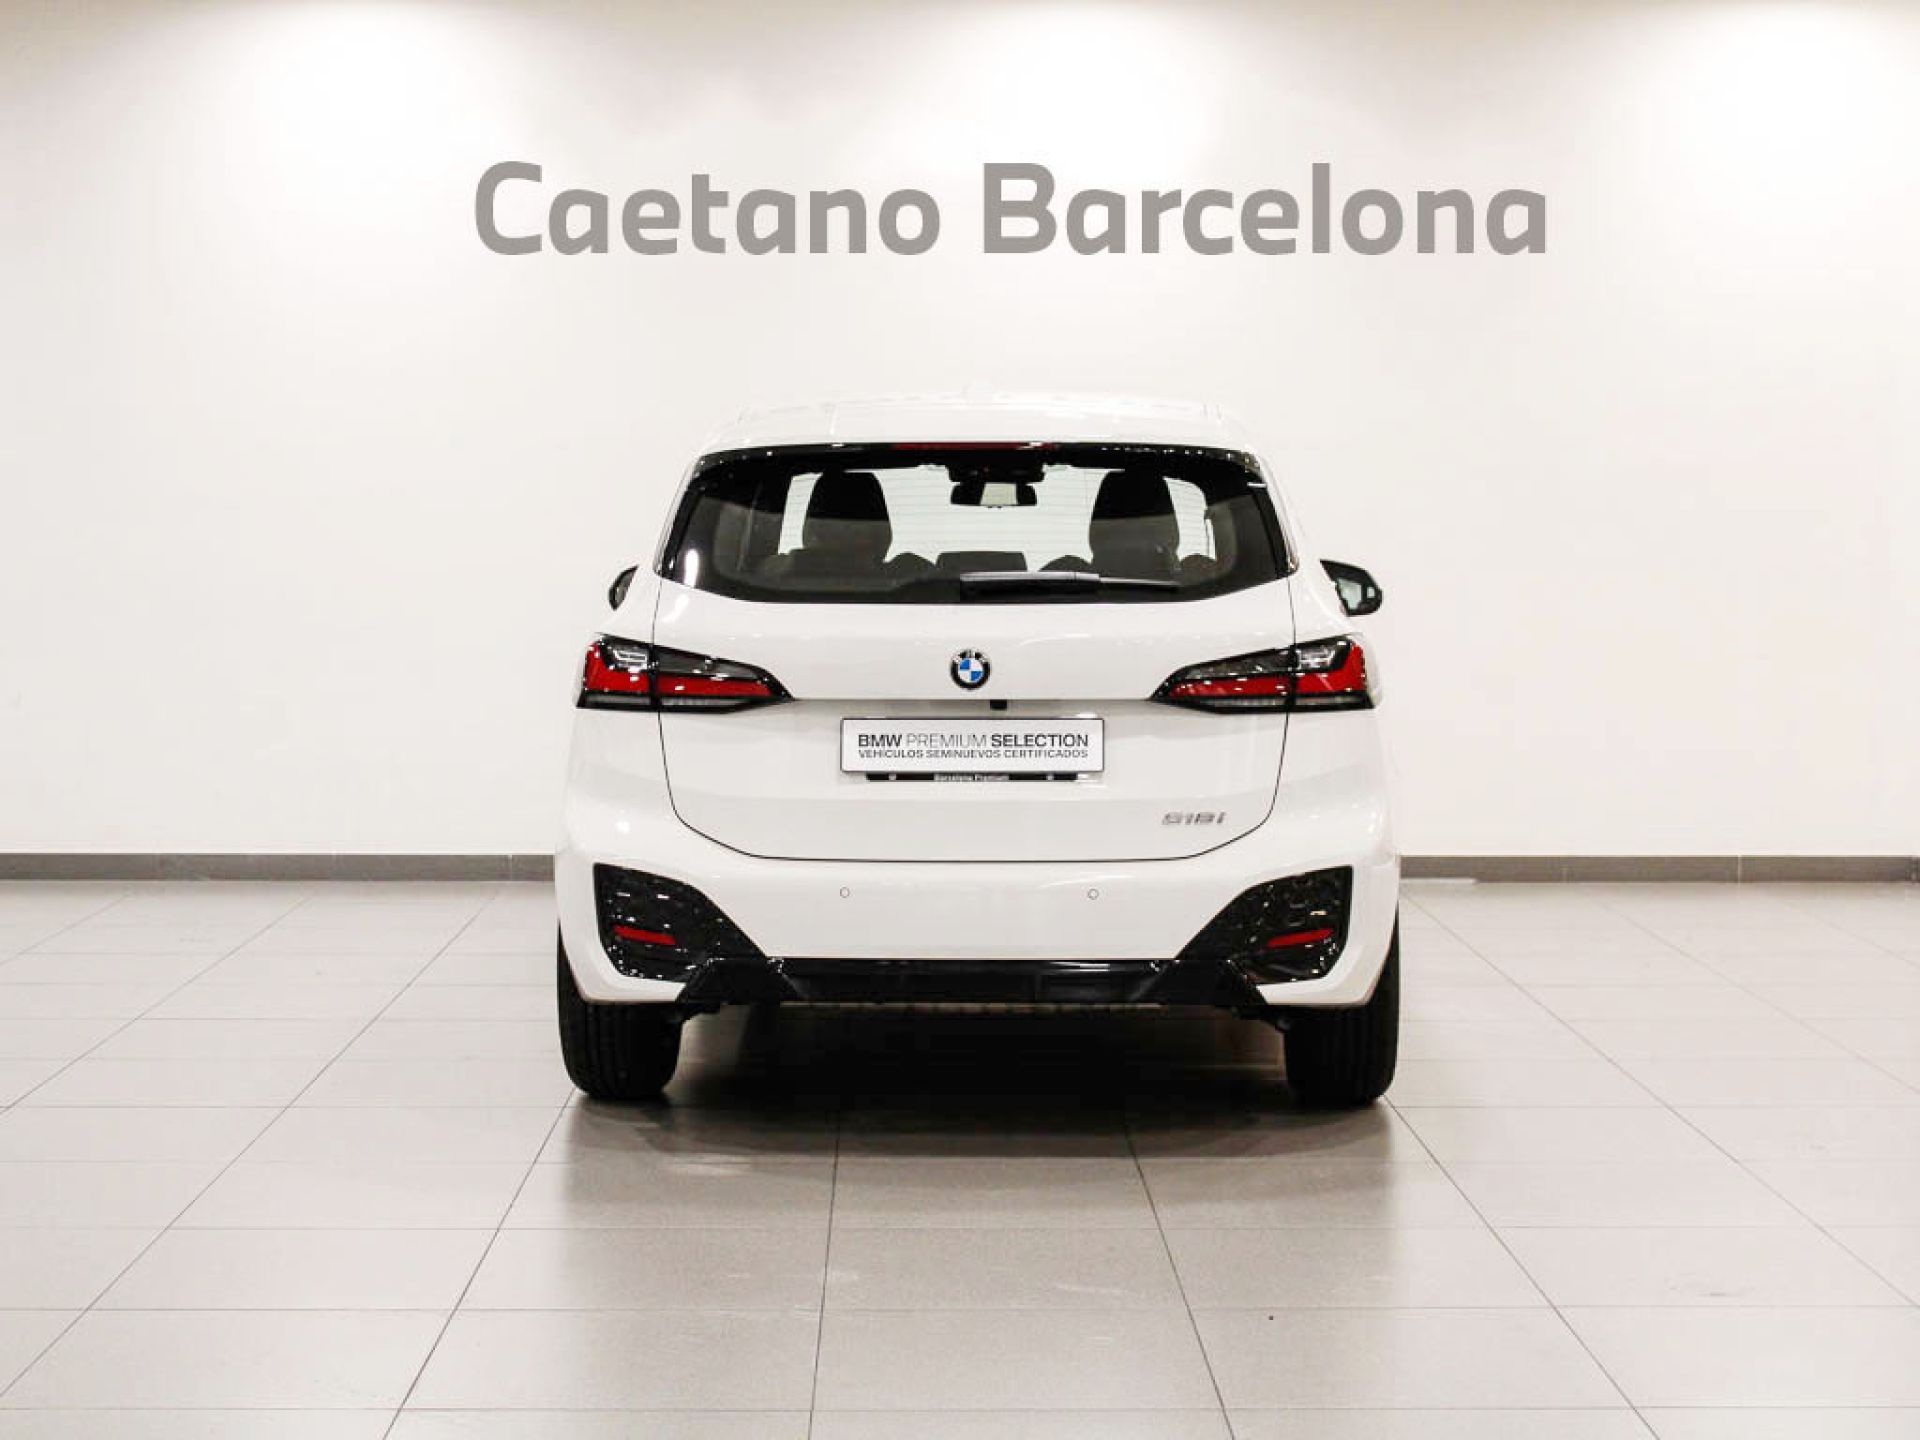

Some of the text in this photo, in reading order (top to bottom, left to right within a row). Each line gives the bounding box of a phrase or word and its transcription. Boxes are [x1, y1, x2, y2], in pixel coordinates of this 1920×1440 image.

[475, 160, 1546, 256] Caetano Barcelona
[858, 734, 1089, 748] BMW PREMIUM SELECTION
